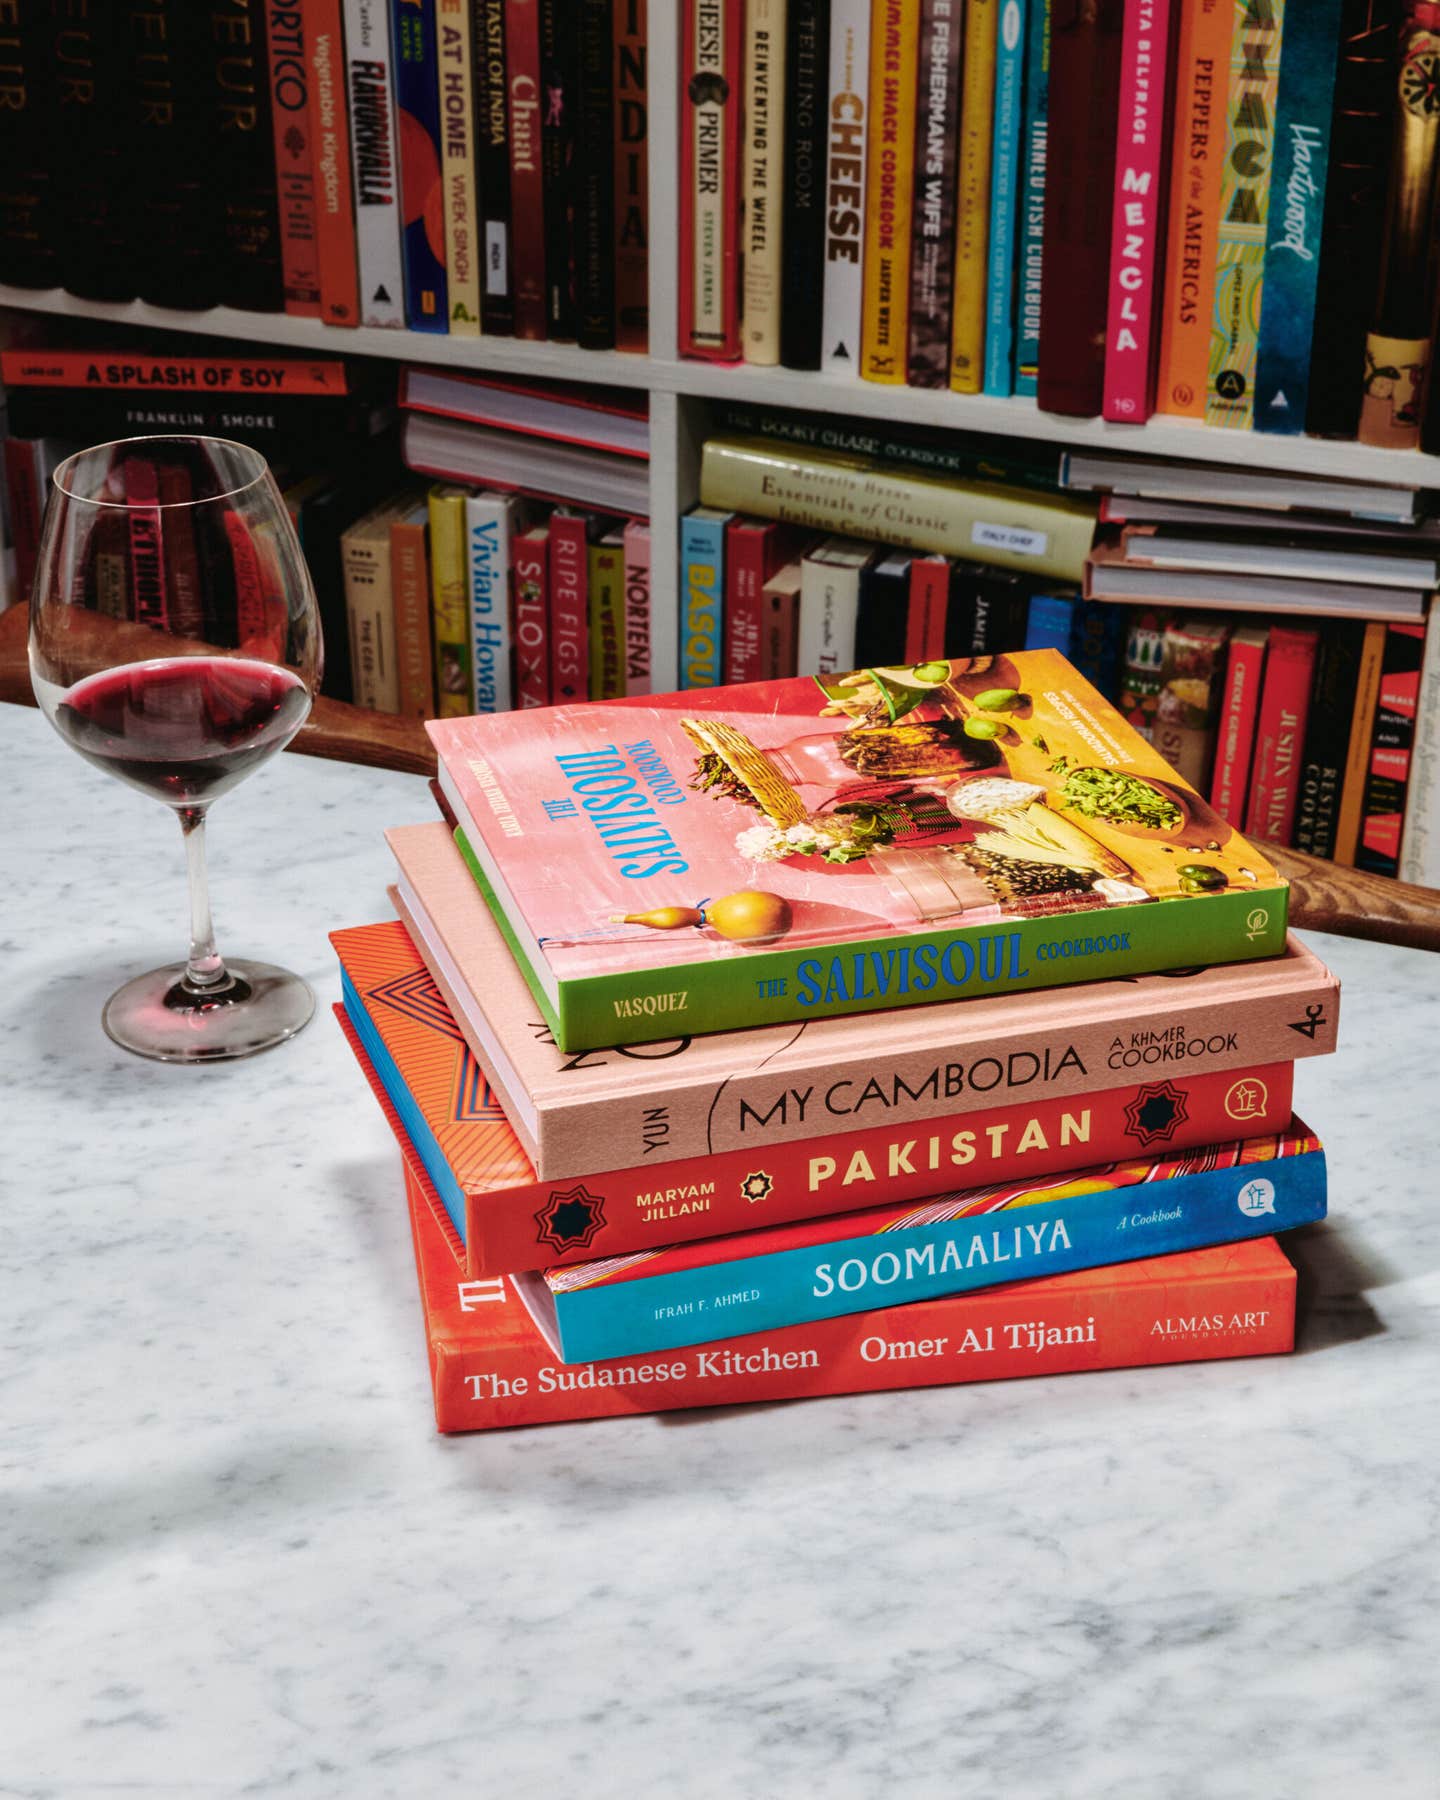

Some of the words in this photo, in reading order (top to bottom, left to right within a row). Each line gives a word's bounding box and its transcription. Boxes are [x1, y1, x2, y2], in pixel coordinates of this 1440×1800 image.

[442, 25, 463, 63] AT
[486, 0, 503, 57] TASTE
[312, 34, 336, 128] Vegetable
[488, 60, 504, 85] OF
[752, 30, 769, 150] REINVENTING
[925, 21, 950, 176] FISHERMAN'S
[1131, 40, 1153, 145] BELFRAGE
[351, 60, 394, 207] FLAVORWALLA
[443, 72, 468, 160] HOME
[489, 88, 506, 145] INDIA
[511, 74, 539, 172] Chaat
[880, 77, 901, 144] SHACK
[1189, 58, 1215, 162] PEPPERS
[319, 131, 339, 213] Kingdom
[698, 111, 719, 195] PRIMER
[751, 158, 768, 189] THE
[795, 139, 814, 209] ROOM
[828, 93, 864, 264] CHEESE
[451, 174, 467, 224] VIVEK
[878, 150, 899, 249] COOKBOOK
[922, 178, 942, 238] WIFE
[1270, 122, 1322, 262] Hartwood
[453, 228, 469, 284] SINGH
[750, 197, 767, 254] WHEEL
[1115, 167, 1153, 352] MEZCLA
[1179, 204, 1206, 326] AMERICAS
[876, 307, 892, 347] WHITE
[86, 365, 101, 383] A
[106, 365, 196, 386] SPLASH
[203, 367, 234, 387] OF
[238, 369, 287, 388] SOY
[127, 410, 205, 426] FRANKLIN
[221, 414, 276, 429] SMOKE
[761, 474, 856, 514] Essentials
[884, 505, 951, 533] Classic
[472, 520, 500, 614] Vivian
[556, 539, 578, 603] RIPE
[556, 612, 579, 677] FIGS
[687, 563, 716, 691] BASQU
[972, 595, 992, 651] JAMIE
[622, 740, 688, 804] COOKBOOK
[1274, 709, 1298, 777] JUSTIN
[541, 798, 580, 822] THE
[555, 744, 690, 880] SALVISOUL
[756, 978, 789, 1000] THE
[797, 931, 1030, 1008] SALVISOUL
[1036, 932, 1132, 966] COOKBOOK
[613, 991, 689, 1019] VASQUEZ
[1107, 1033, 1239, 1071] COOKBOOK
[1110, 1036, 1125, 1051] A
[1130, 1026, 1186, 1046] KHMER
[739, 1086, 815, 1132] MY
[824, 1044, 1088, 1116] CAMBODIA
[642, 1106, 670, 1155] YUN
[808, 1109, 1092, 1193] PAKISTAN
[636, 1181, 716, 1208] MARYAM
[640, 1199, 711, 1223] JILLANI
[1116, 1216, 1127, 1230] A
[1131, 1206, 1183, 1229] Cookbook
[812, 1218, 1073, 1298] SOOMAALIYA
[654, 1300, 695, 1321] IFRAH
[698, 1296, 710, 1313] F.
[714, 1288, 761, 1309] AHMED
[1150, 1314, 1224, 1336] ALMAS
[1228, 1311, 1271, 1329] ART
[1161, 1328, 1257, 1342] FOUNDATION
[859, 1335, 949, 1363] Omer
[957, 1326, 995, 1354] Al
[1003, 1316, 1097, 1353] Tijani
[464, 1373, 529, 1402] The
[537, 1358, 688, 1394] Sudanese
[696, 1346, 821, 1379] Kitchen
